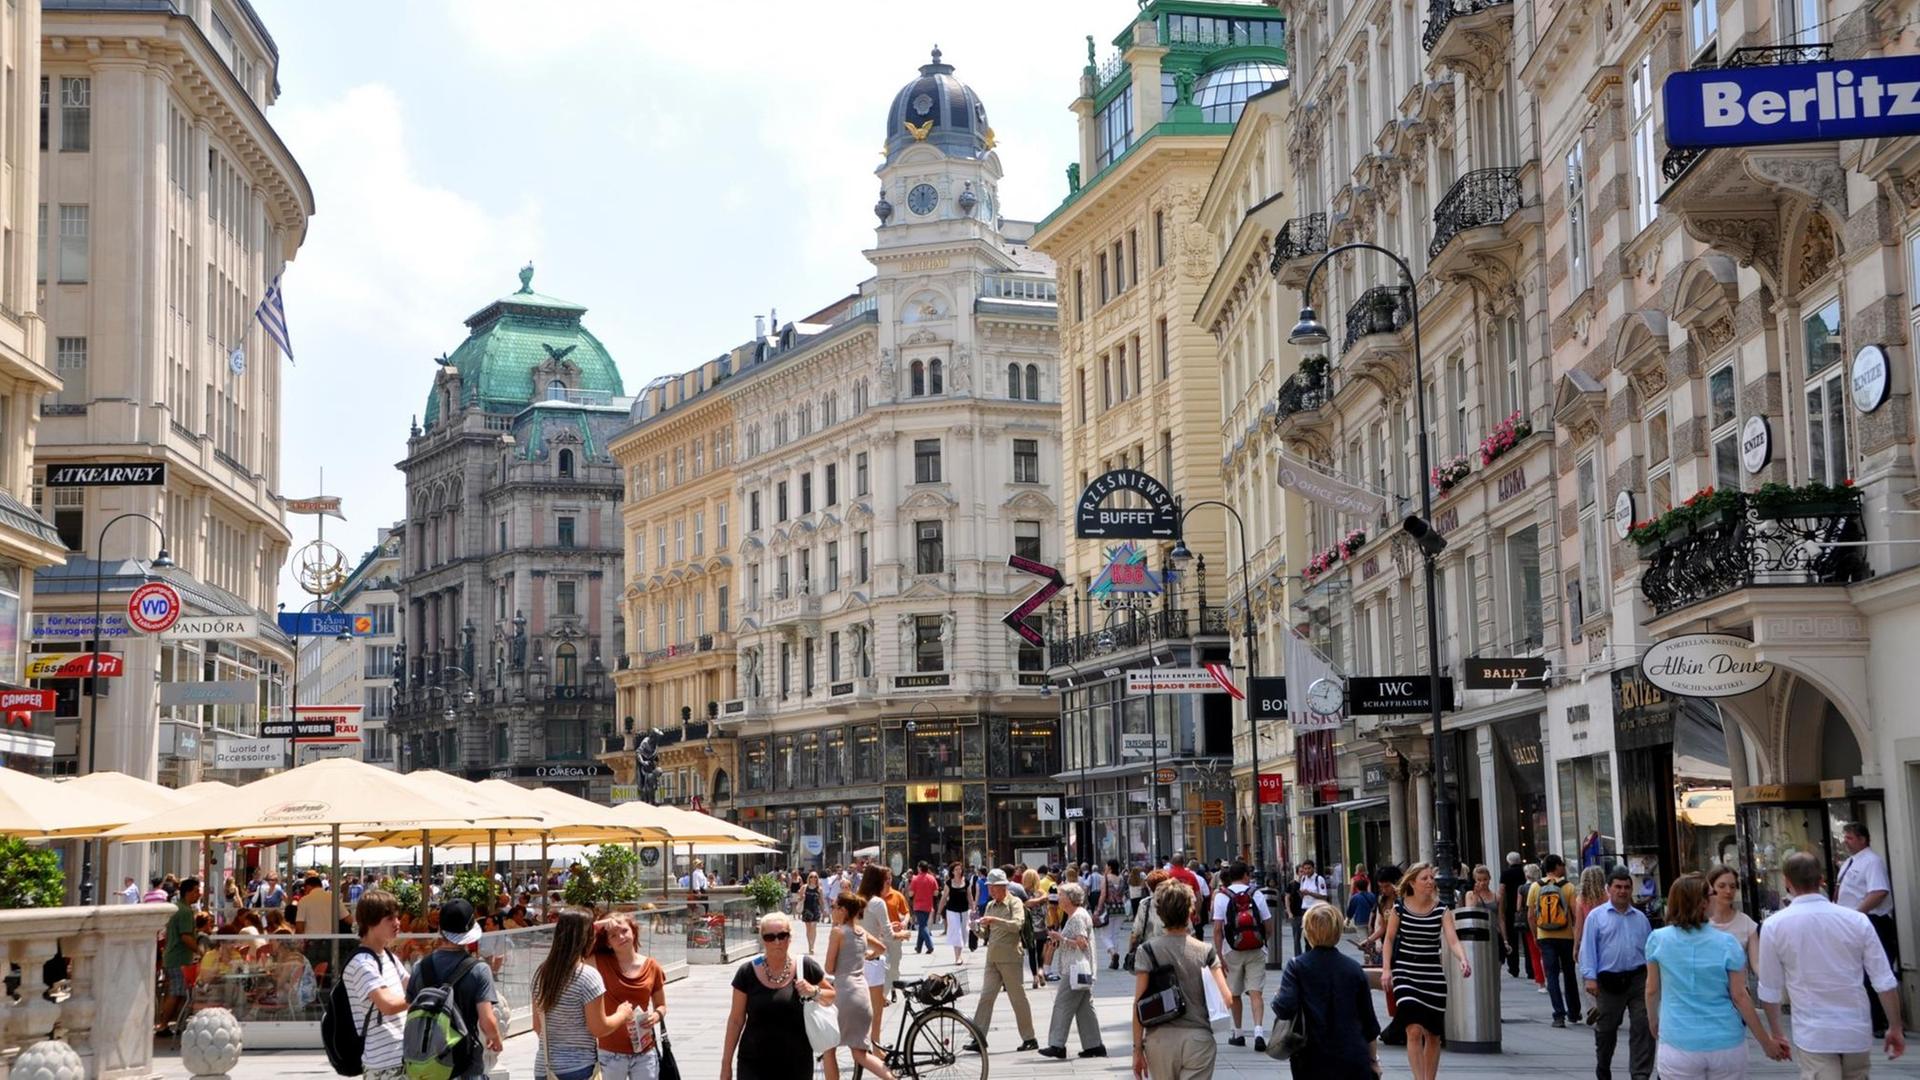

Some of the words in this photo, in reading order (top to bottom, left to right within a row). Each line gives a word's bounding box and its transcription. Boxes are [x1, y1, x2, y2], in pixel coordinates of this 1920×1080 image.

[1702, 69, 1920, 128] Berlitz
[1853, 363, 1882, 392] KNIZE
[1744, 432, 1765, 454] KNIZE
[51, 467, 160, 484] ATKEARNEY
[1299, 481, 1332, 499] OFFICE
[1335, 496, 1373, 513] CENTER
[1100, 512, 1155, 524] BUFFET
[142, 600, 168, 615] VVD
[48, 616, 62, 626] für
[106, 616, 122, 626] der
[33, 627, 129, 637] Volkswagenruppe
[32, 662, 83, 674] Eissalon
[1650, 656, 1706, 675] Albin
[1708, 654, 1766, 674] Denk
[1483, 669, 1527, 678] BALLY
[1379, 682, 1414, 697] IWC
[1, 694, 42, 707] CAMPER
[1363, 700, 1429, 708] SCHAFFHAUSEN
[298, 725, 331, 733] WEBER
[229, 744, 257, 753] World
[260, 744, 270, 753] of
[549, 767, 584, 777] OMEGA
